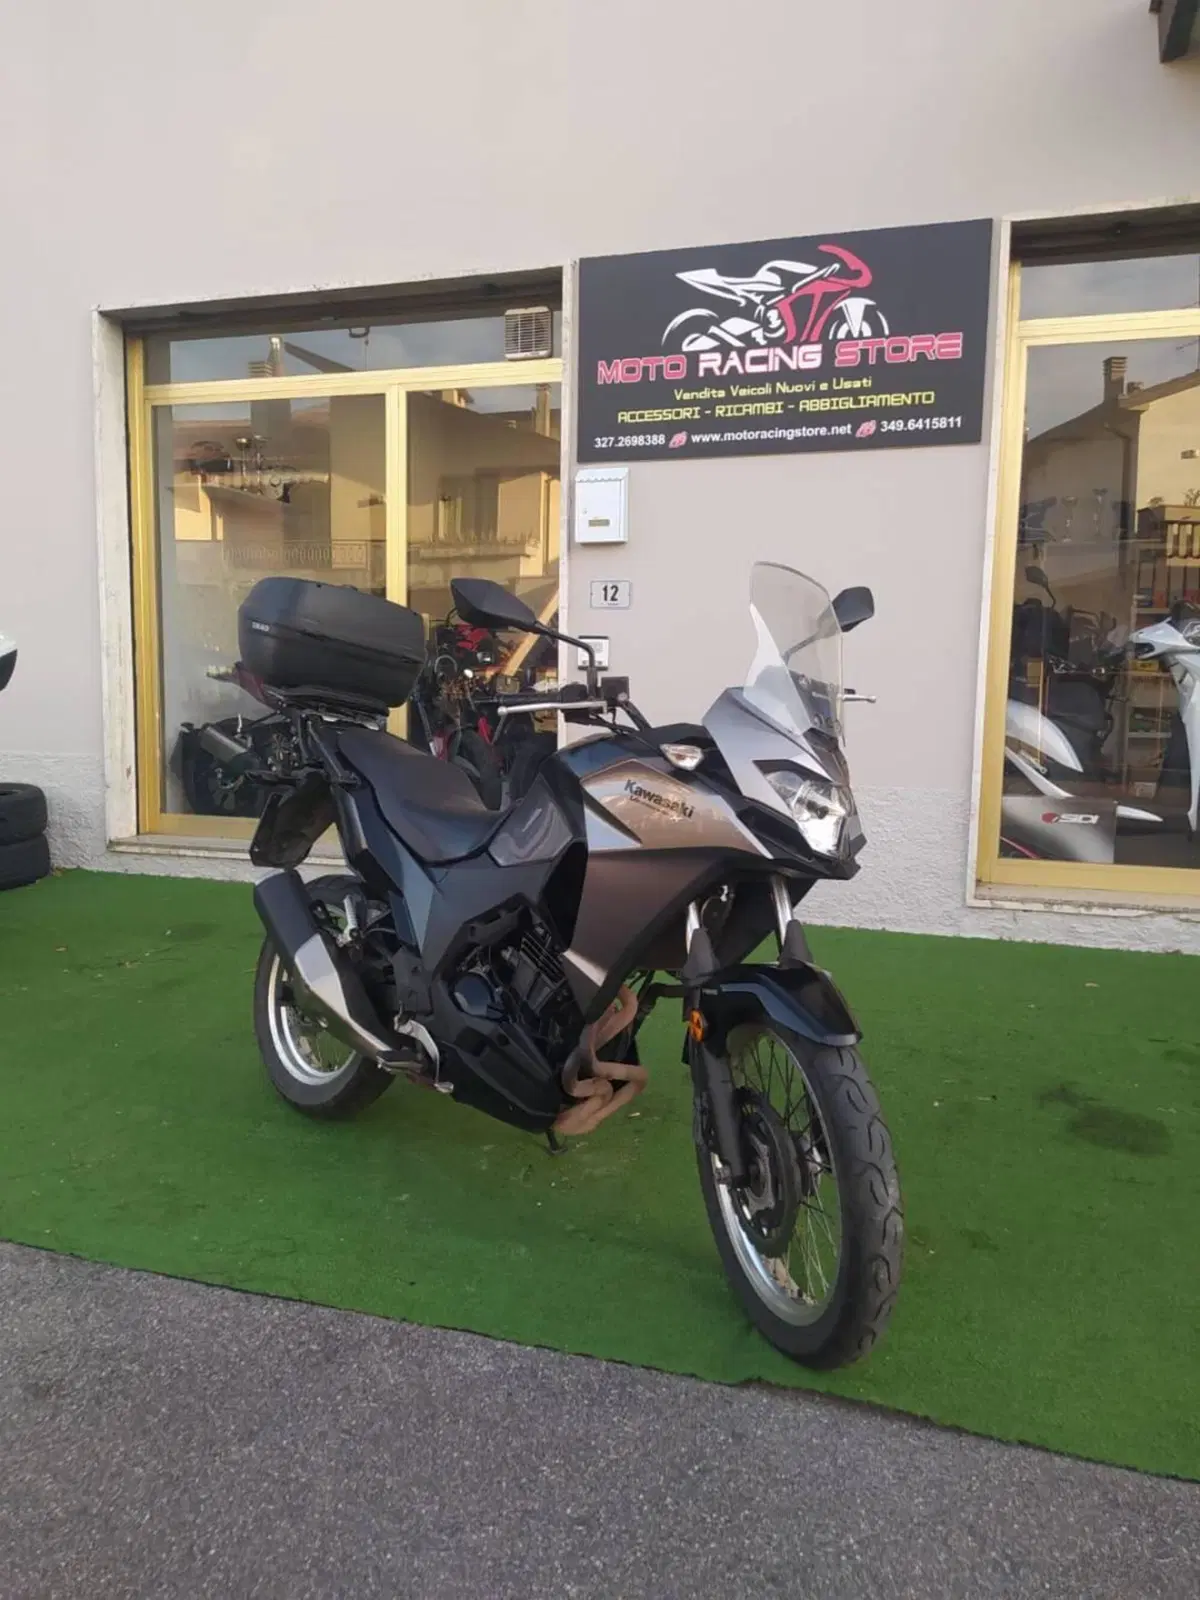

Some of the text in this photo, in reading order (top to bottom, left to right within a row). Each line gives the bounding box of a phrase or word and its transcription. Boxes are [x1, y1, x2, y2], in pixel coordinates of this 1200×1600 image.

[597, 332, 963, 385] MOTO RACING STORE
[673, 376, 872, 401] Vendita Veicoli Nuovi e Usati
[617, 406, 701, 424] ACCESSORI
[715, 401, 784, 418] RICAMBI
[799, 391, 935, 412] ABBIGLIAMENTO
[594, 416, 962, 449] 327.2698388 www.motoracingstore.net 349.6415811
[602, 584, 619, 602] 12
[624, 779, 696, 818] Kawasaki
